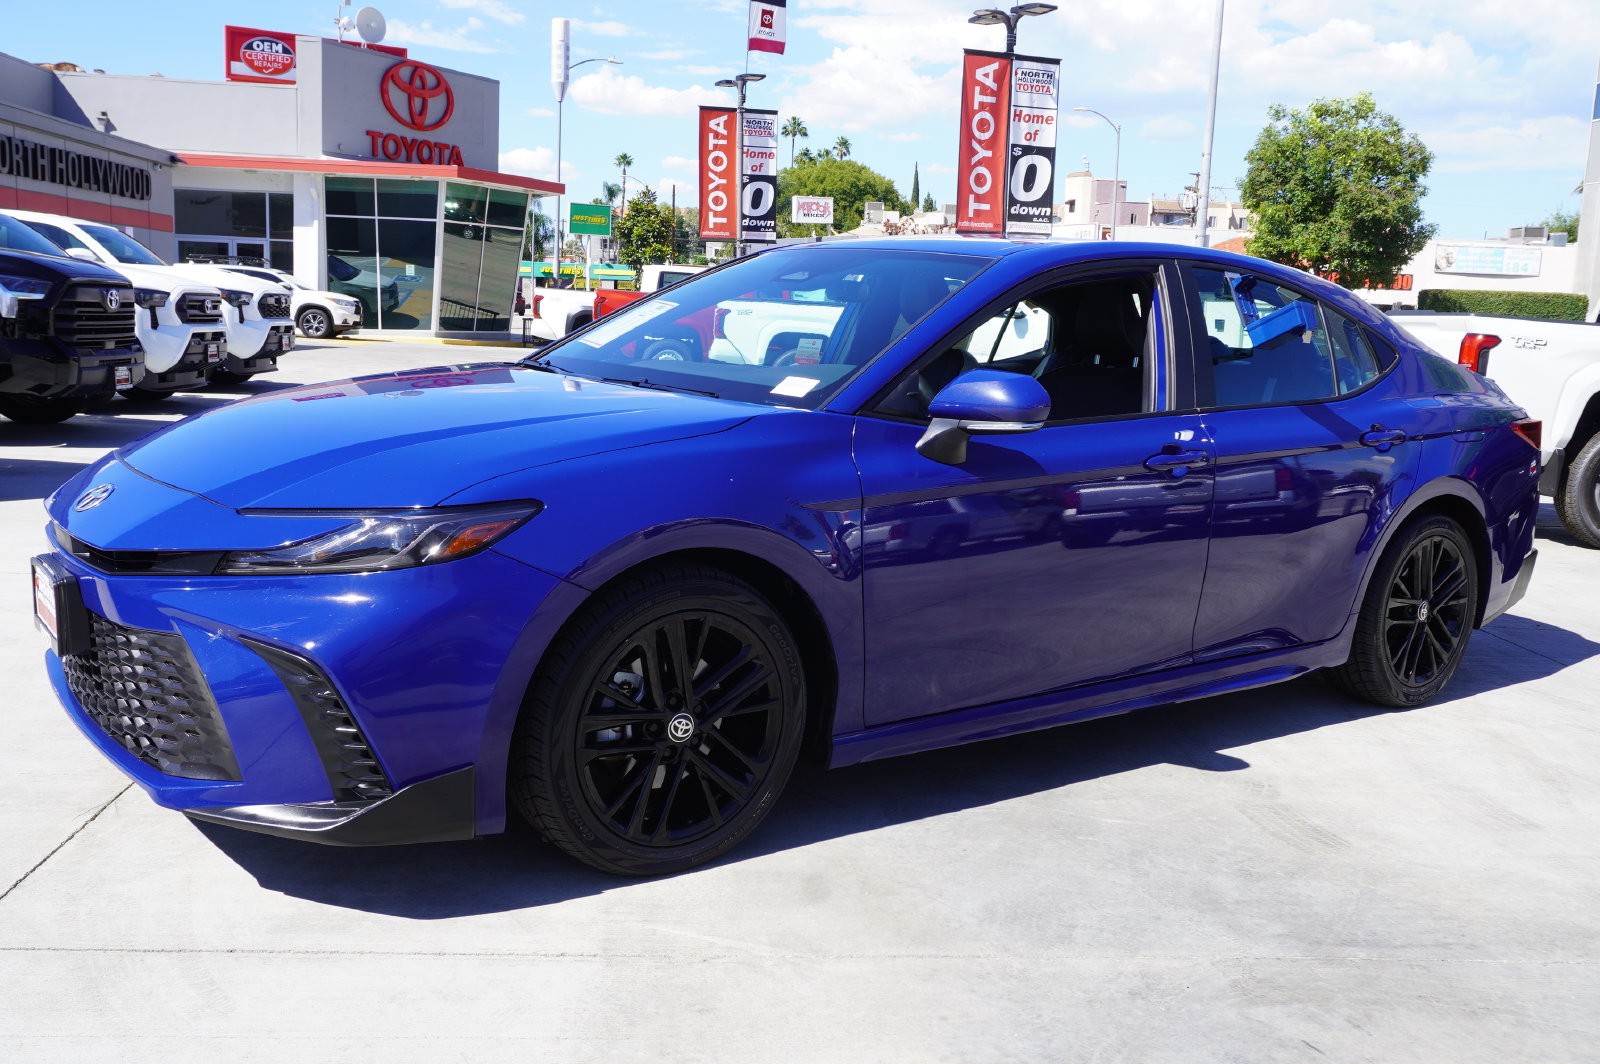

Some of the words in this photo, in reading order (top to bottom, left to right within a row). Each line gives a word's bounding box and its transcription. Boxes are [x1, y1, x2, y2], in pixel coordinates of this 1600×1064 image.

[252, 40, 283, 54] OEM
[245, 51, 291, 64] CERTIFIED
[254, 60, 283, 69] REPAIRS
[1021, 70, 1053, 79] NORTH
[1017, 77, 1052, 85] HOLLYWOOD
[1017, 82, 1051, 93] TOYOTA
[1012, 109, 1054, 125] Home
[968, 62, 1000, 218] TOYOTA
[1024, 130, 1039, 142] of
[366, 130, 464, 167] TOYOTA
[742, 149, 775, 160] Home
[0, 133, 49, 181] ORTH
[54, 147, 152, 201] HOLLYWOOD
[708, 115, 728, 229] TOYOTA
[751, 162, 764, 172] of
[1010, 204, 1051, 216] down
[742, 218, 774, 227] down
